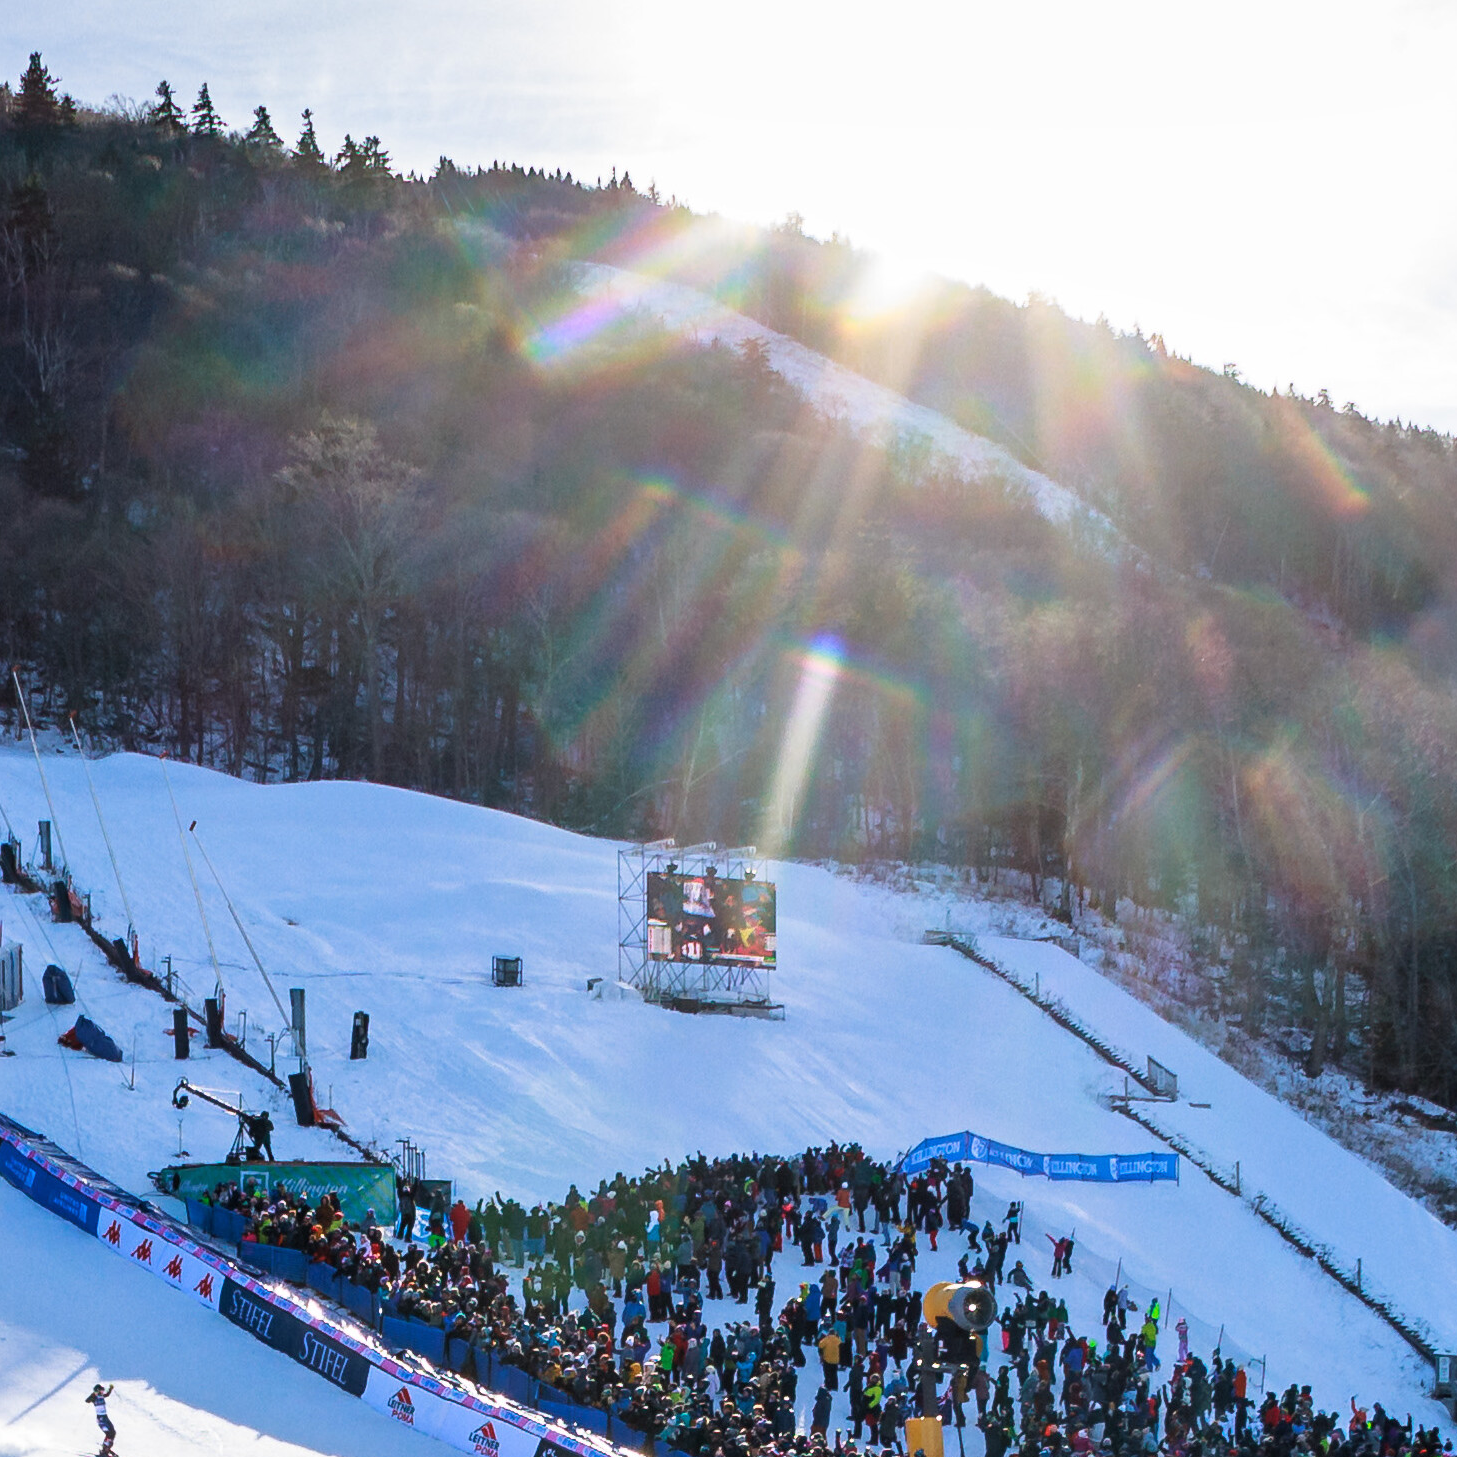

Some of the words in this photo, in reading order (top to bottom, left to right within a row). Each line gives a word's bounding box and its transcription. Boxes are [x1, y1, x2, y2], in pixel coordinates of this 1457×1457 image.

[229, 1289, 273, 1340] STIFEL
[299, 1331, 346, 1385] STIFEL
[387, 1398, 415, 1416] LEITNER
[391, 1409, 415, 1426] POMA
[468, 1433, 500, 1450] LEITNER
